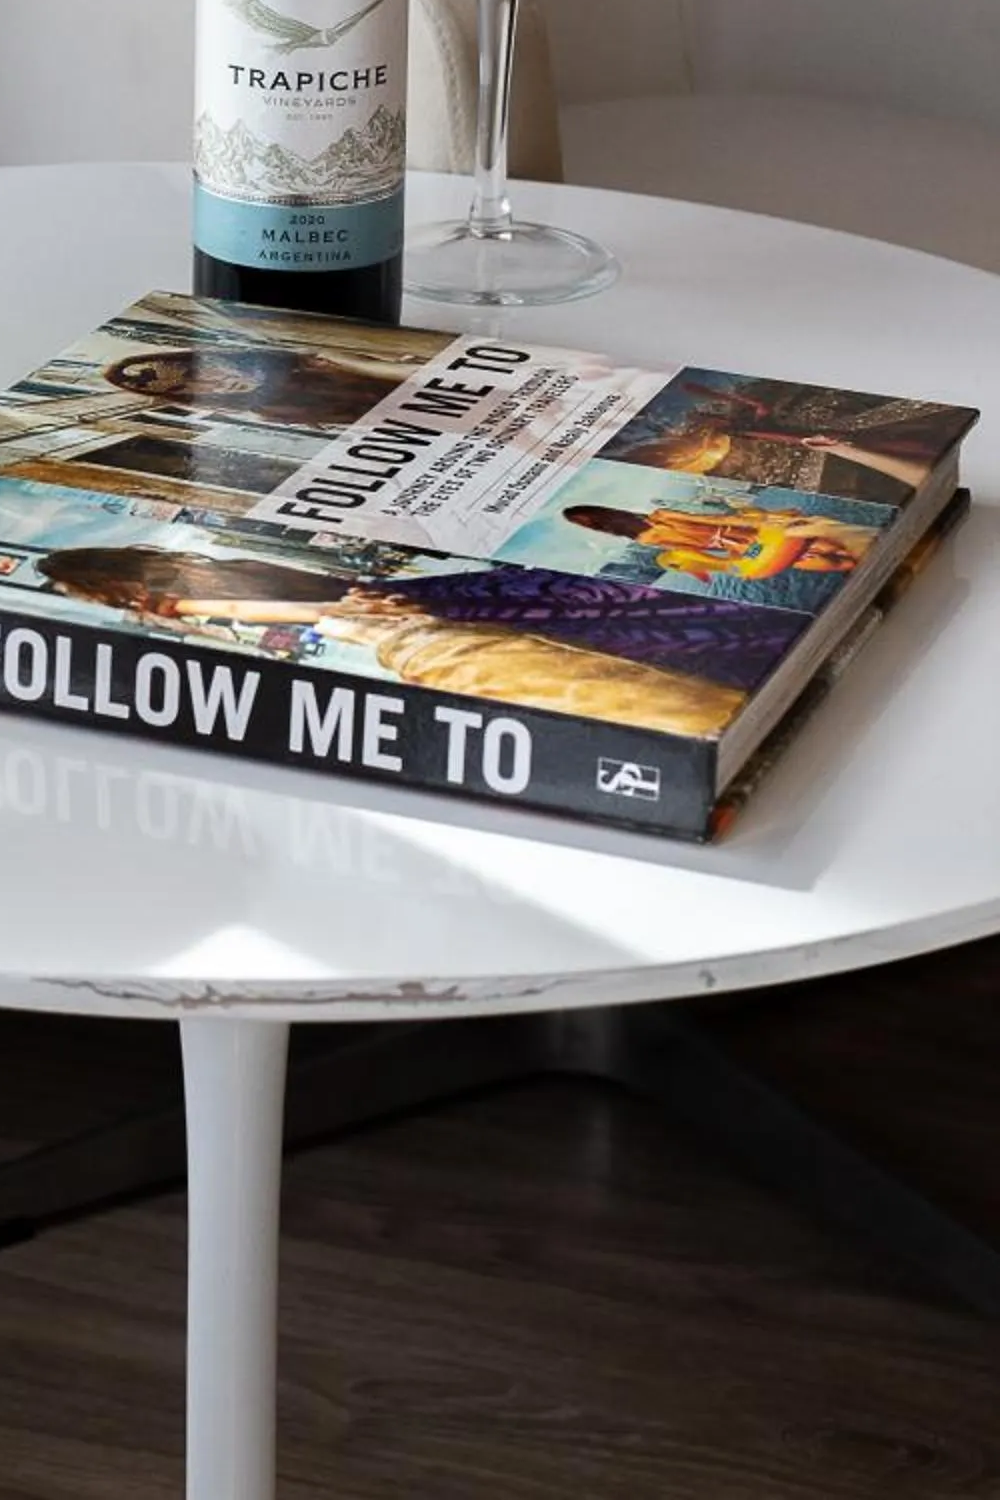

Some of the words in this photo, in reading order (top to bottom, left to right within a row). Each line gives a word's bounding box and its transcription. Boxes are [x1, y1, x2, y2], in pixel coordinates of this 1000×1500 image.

[228, 64, 388, 92] TRAPICHE
[262, 95, 357, 108] VINEYARDS
[289, 214, 326, 225] 2020
[262, 229, 349, 244] MALBEC
[257, 250, 352, 262] ARGENTINA
[276, 418, 443, 524] FOLLOW
[398, 377, 495, 419] ME
[447, 345, 531, 375] TO
[389, 472, 439, 509] JOURNEY
[428, 441, 474, 473] AROUND
[463, 425, 491, 442] THE
[411, 500, 440, 518] THE
[430, 479, 463, 501] EYES
[453, 467, 476, 480] OF
[465, 448, 497, 468] TWO
[288, 678, 405, 772] ME
[434, 705, 532, 795] TO
